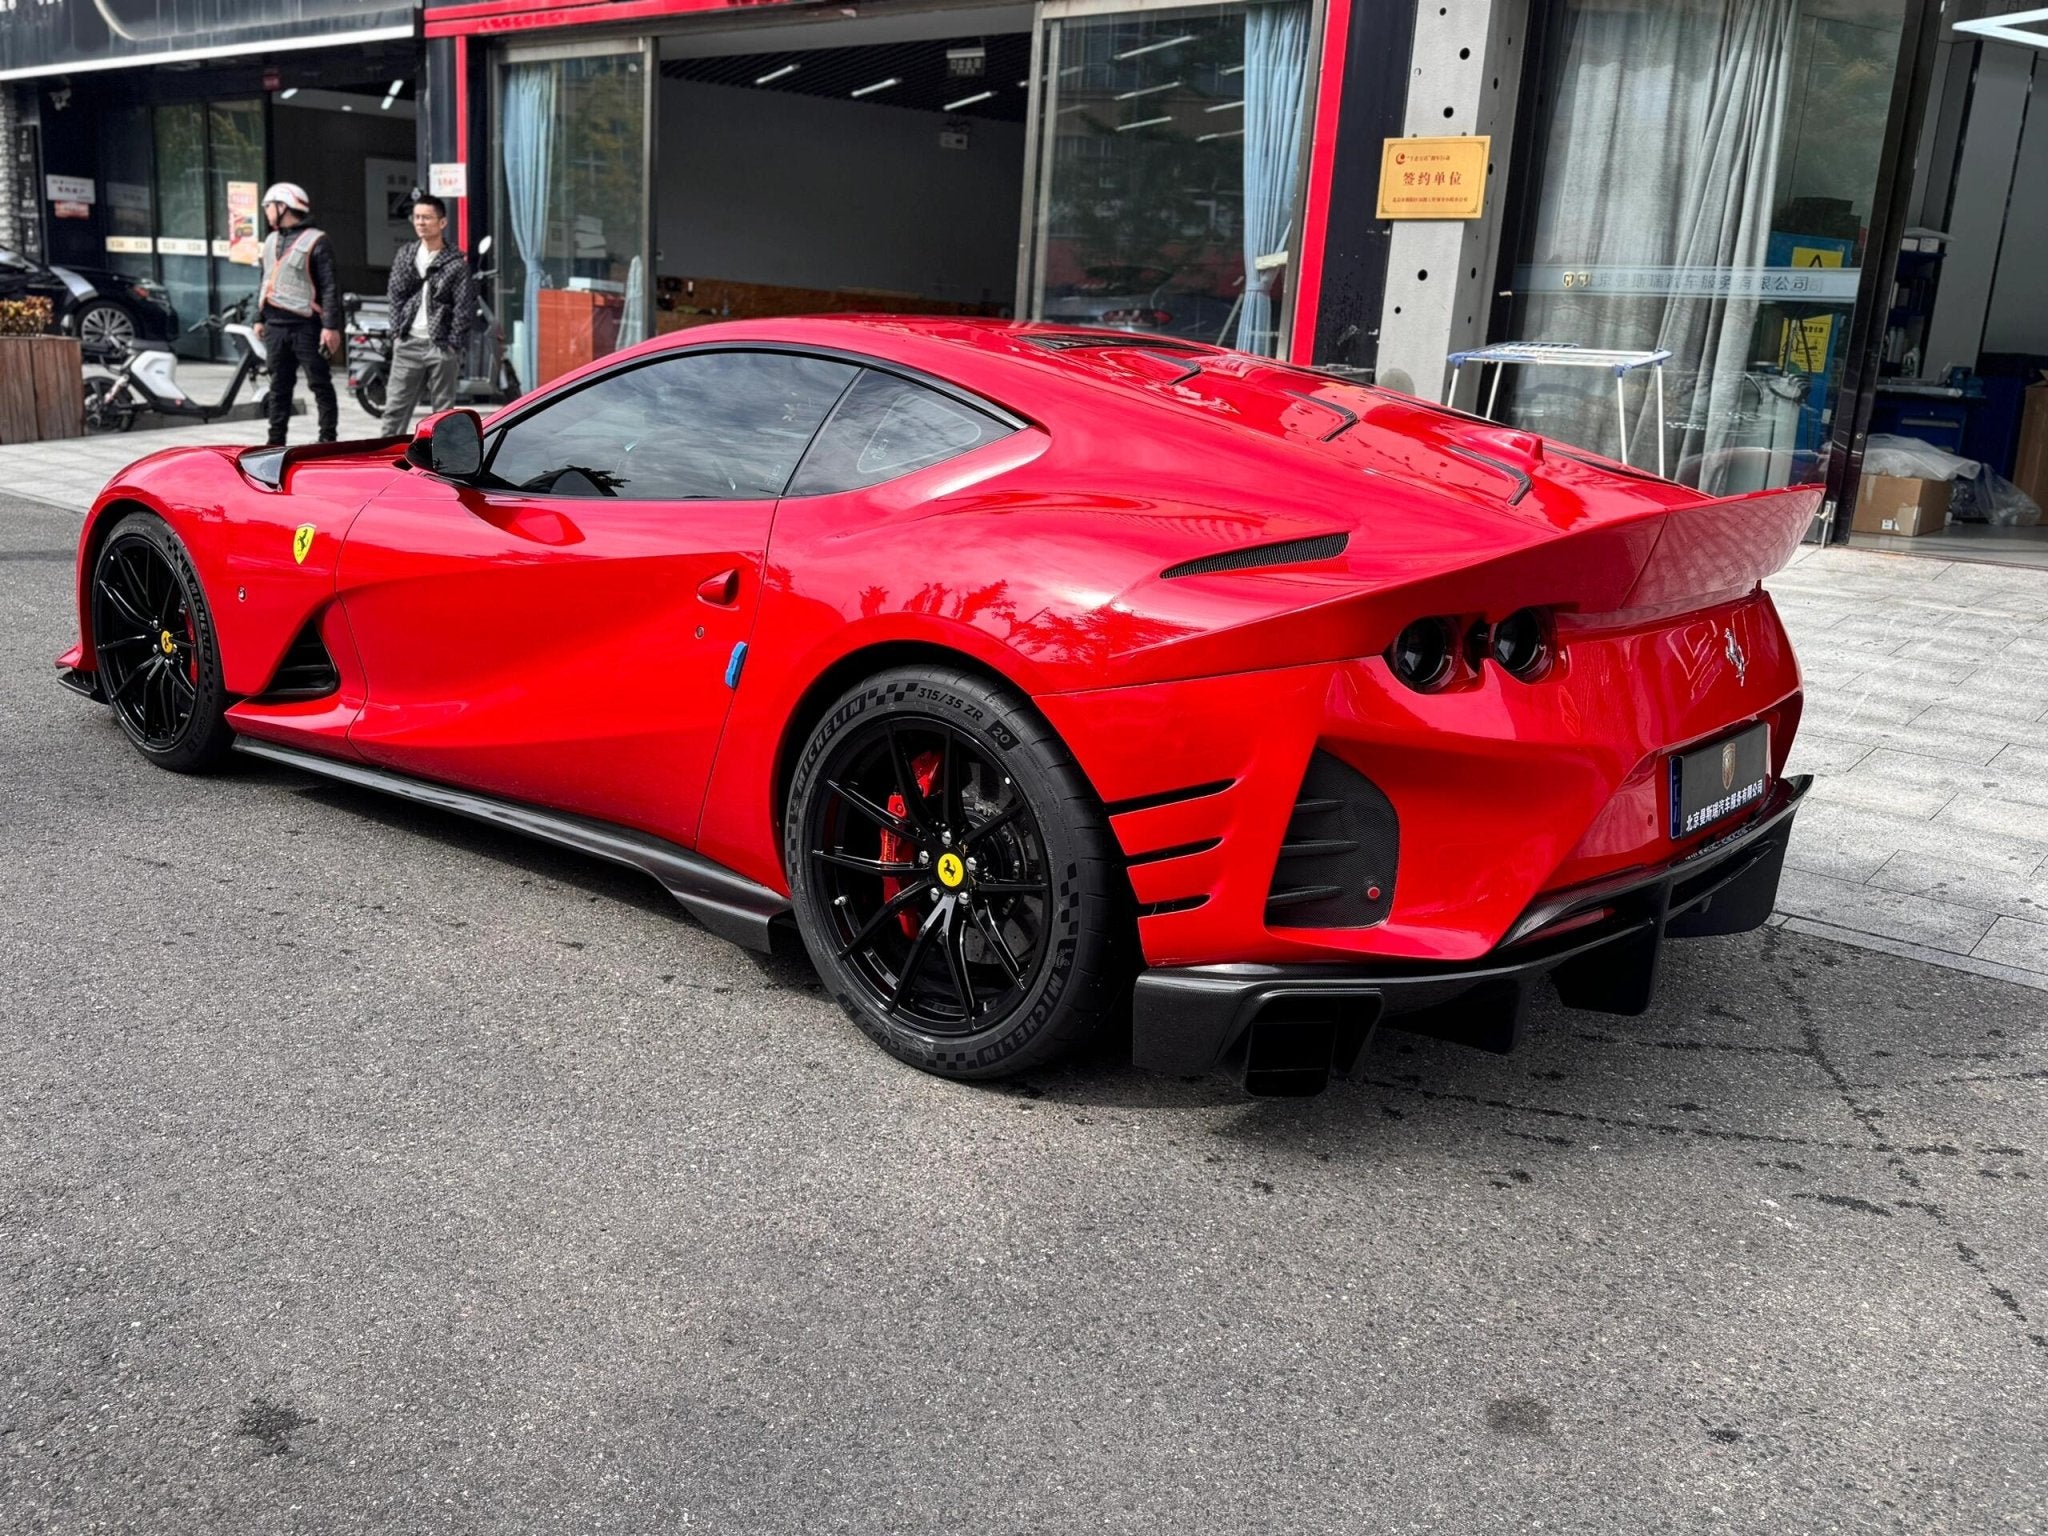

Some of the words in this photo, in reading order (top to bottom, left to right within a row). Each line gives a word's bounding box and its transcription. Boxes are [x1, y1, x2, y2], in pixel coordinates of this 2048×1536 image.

[1402, 171, 1463, 186] 签约单位
[189, 582, 211, 661] MICHELIN
[917, 687, 964, 709] 315/35
[963, 703, 984, 722] ZR
[991, 726, 1011, 744] 20
[796, 698, 861, 793] MICHELIN
[1686, 778, 1763, 832] 北京曼斯瑞汽车服务有限公司
[872, 1031, 900, 1051] CUP
[982, 972, 1064, 1062] MICHELIN
